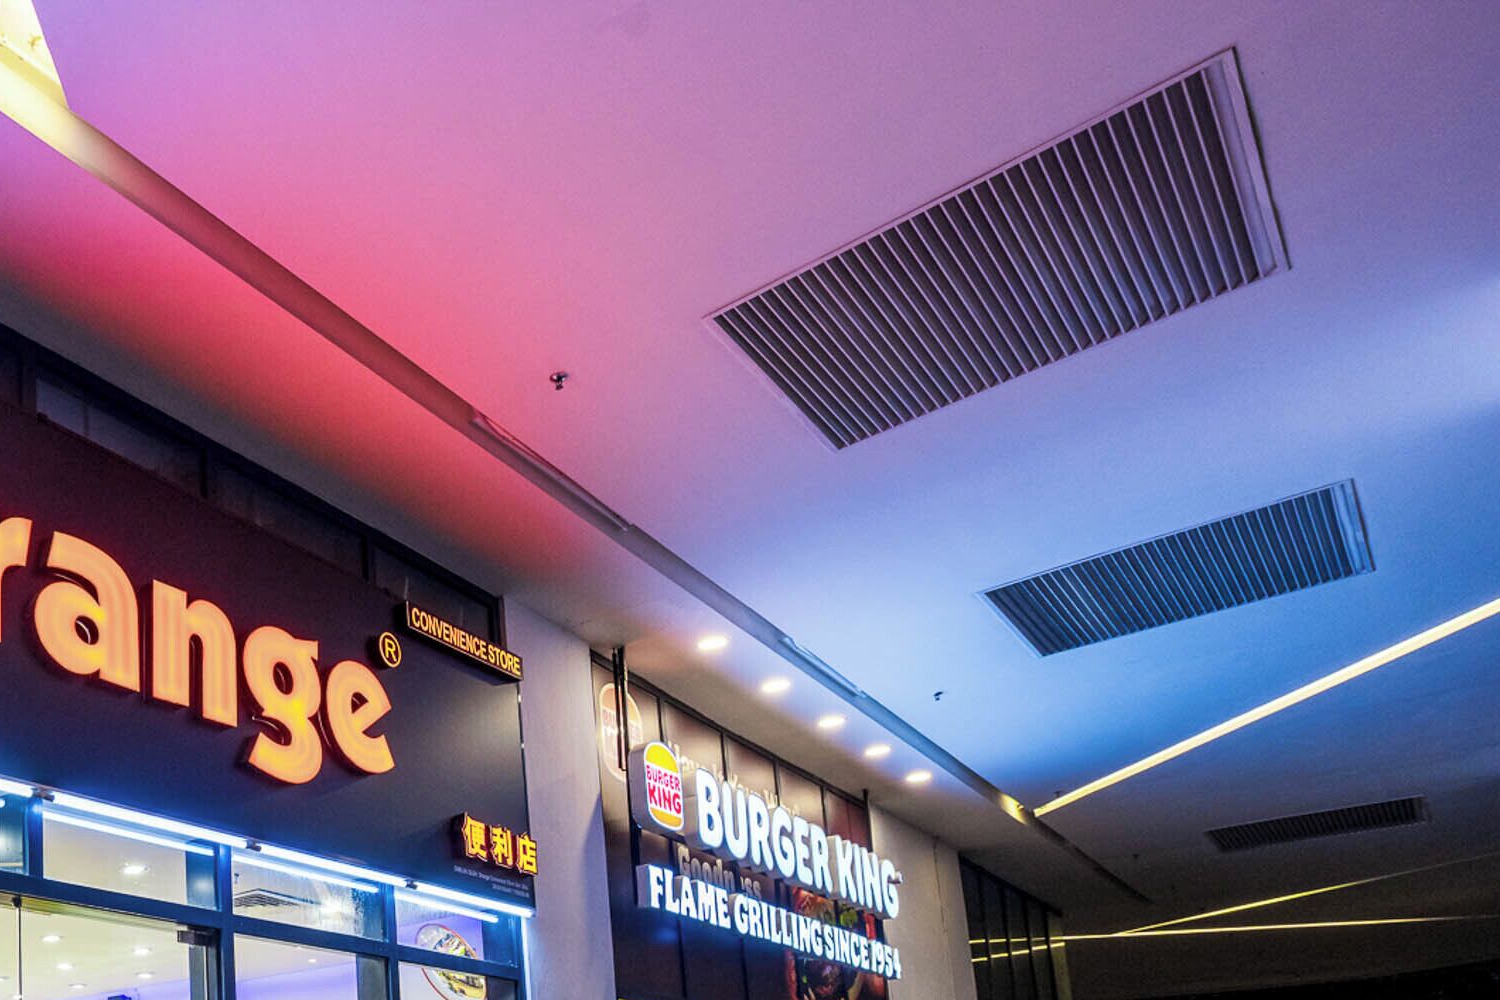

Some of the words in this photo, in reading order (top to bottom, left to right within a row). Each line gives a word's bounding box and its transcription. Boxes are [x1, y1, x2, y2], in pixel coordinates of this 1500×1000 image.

[411, 607, 487, 661] CONVENIENCE
[486, 644, 522, 676] STORE
[645, 764, 681, 792] BURGER
[648, 784, 682, 815] KING
[464, 815, 538, 875] 便利店
[677, 843, 762, 899] Goodnss
[696, 768, 834, 894] BURGER
[834, 834, 900, 919] KING
[649, 864, 731, 930] FLAME
[733, 893, 822, 956] GRILLING
[822, 923, 871, 968] SINCE
[870, 940, 902, 979] 1954
